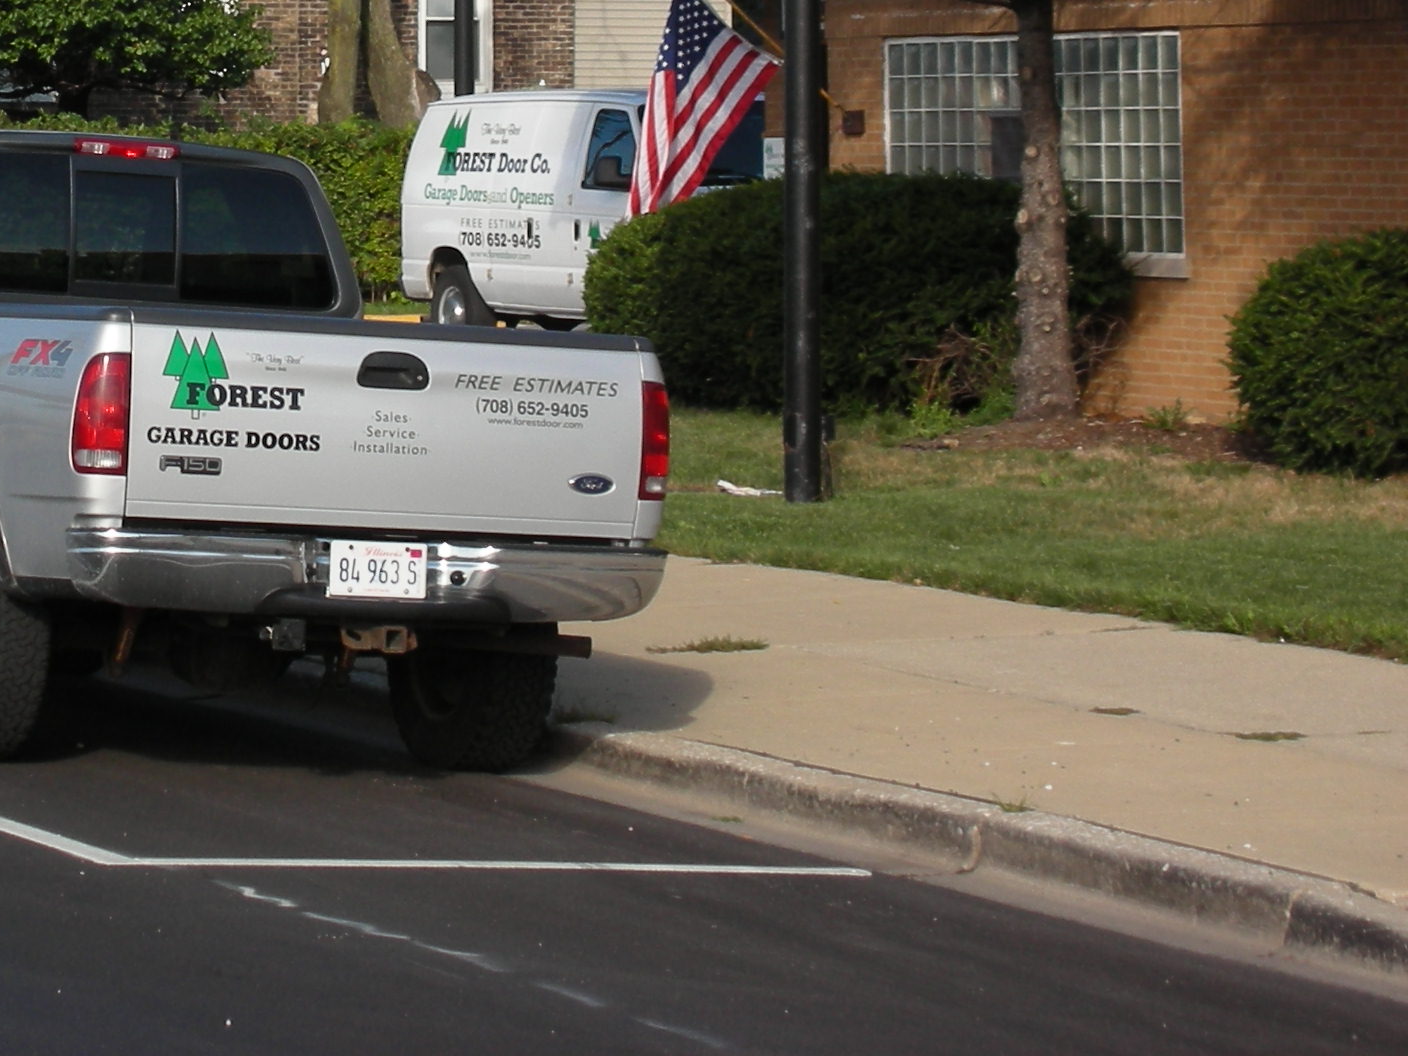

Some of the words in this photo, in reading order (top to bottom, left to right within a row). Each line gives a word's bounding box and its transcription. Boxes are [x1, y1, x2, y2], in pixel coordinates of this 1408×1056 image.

[445, 151, 495, 173] FOREST
[497, 152, 528, 174] Door
[530, 153, 551, 174] Co.
[424, 183, 457, 206] Garage
[459, 184, 488, 203] Doors
[510, 186, 554, 209] Openers
[460, 217, 483, 229] FREE
[488, 218, 541, 231] ESTIMATS
[10, 338, 74, 366] FX4
[186, 382, 305, 411] FOREST
[455, 374, 502, 391] FREE
[513, 377, 618, 398] ESTIMATES
[375, 410, 409, 423] Sales
[475, 397, 514, 416] (708)
[517, 401, 589, 419] 652-9405
[366, 425, 416, 440] Service
[488, 417, 584, 430] www.forestdoor.com
[147, 426, 239, 447] GARAGE
[245, 432, 321, 451] DOORS
[353, 441, 428, 456] Installation
[339, 557, 360, 583] 84
[368, 559, 400, 584] 963
